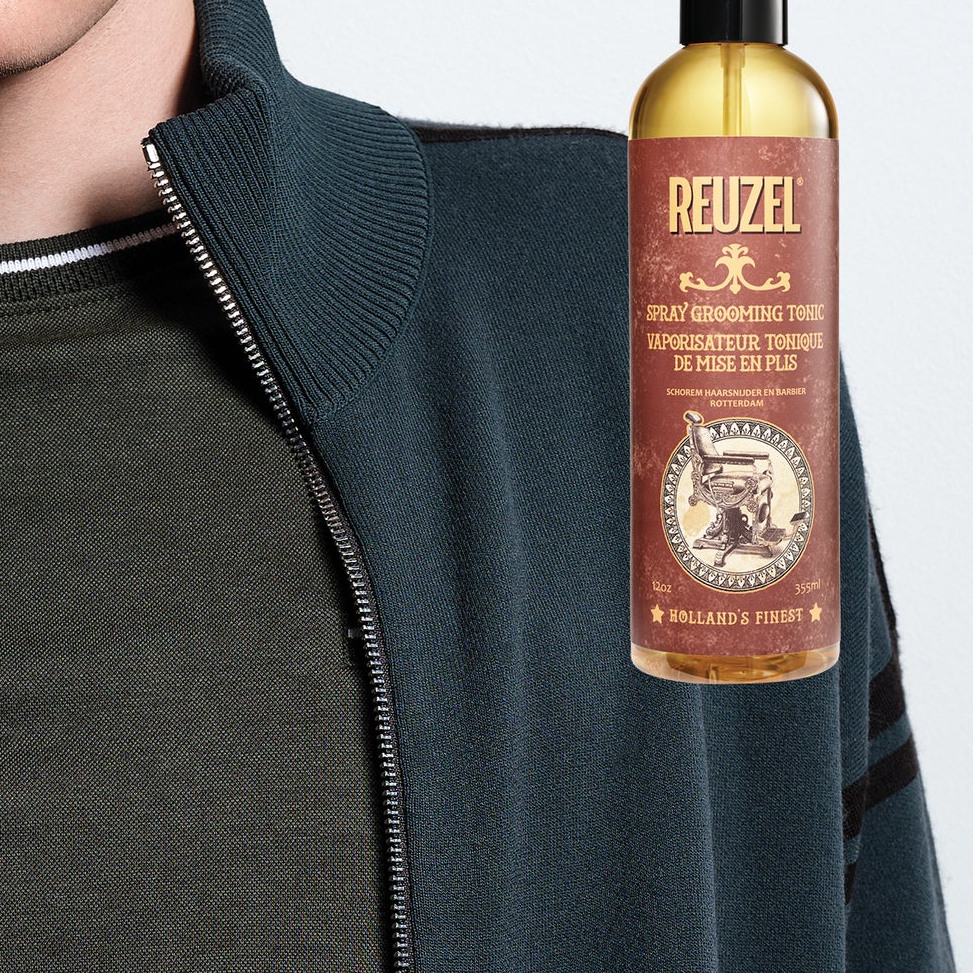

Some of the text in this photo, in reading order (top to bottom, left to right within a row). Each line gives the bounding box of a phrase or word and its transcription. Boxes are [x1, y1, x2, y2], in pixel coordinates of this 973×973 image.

[647, 302, 825, 323] SPRAY GROOMING TONIC
[647, 332, 824, 352] VAPORISATEUR TONIQUE
[674, 354, 798, 372] DE MISE EN PLIS
[666, 387, 806, 397] SCHOREM HAARSNIJDER EN BARBIER
[710, 399, 764, 408] ROTTERDAM
[652, 580, 672, 593] 12oz
[795, 581, 821, 595] 355ml
[669, 607, 803, 626] HOLLAND'S FINEST
